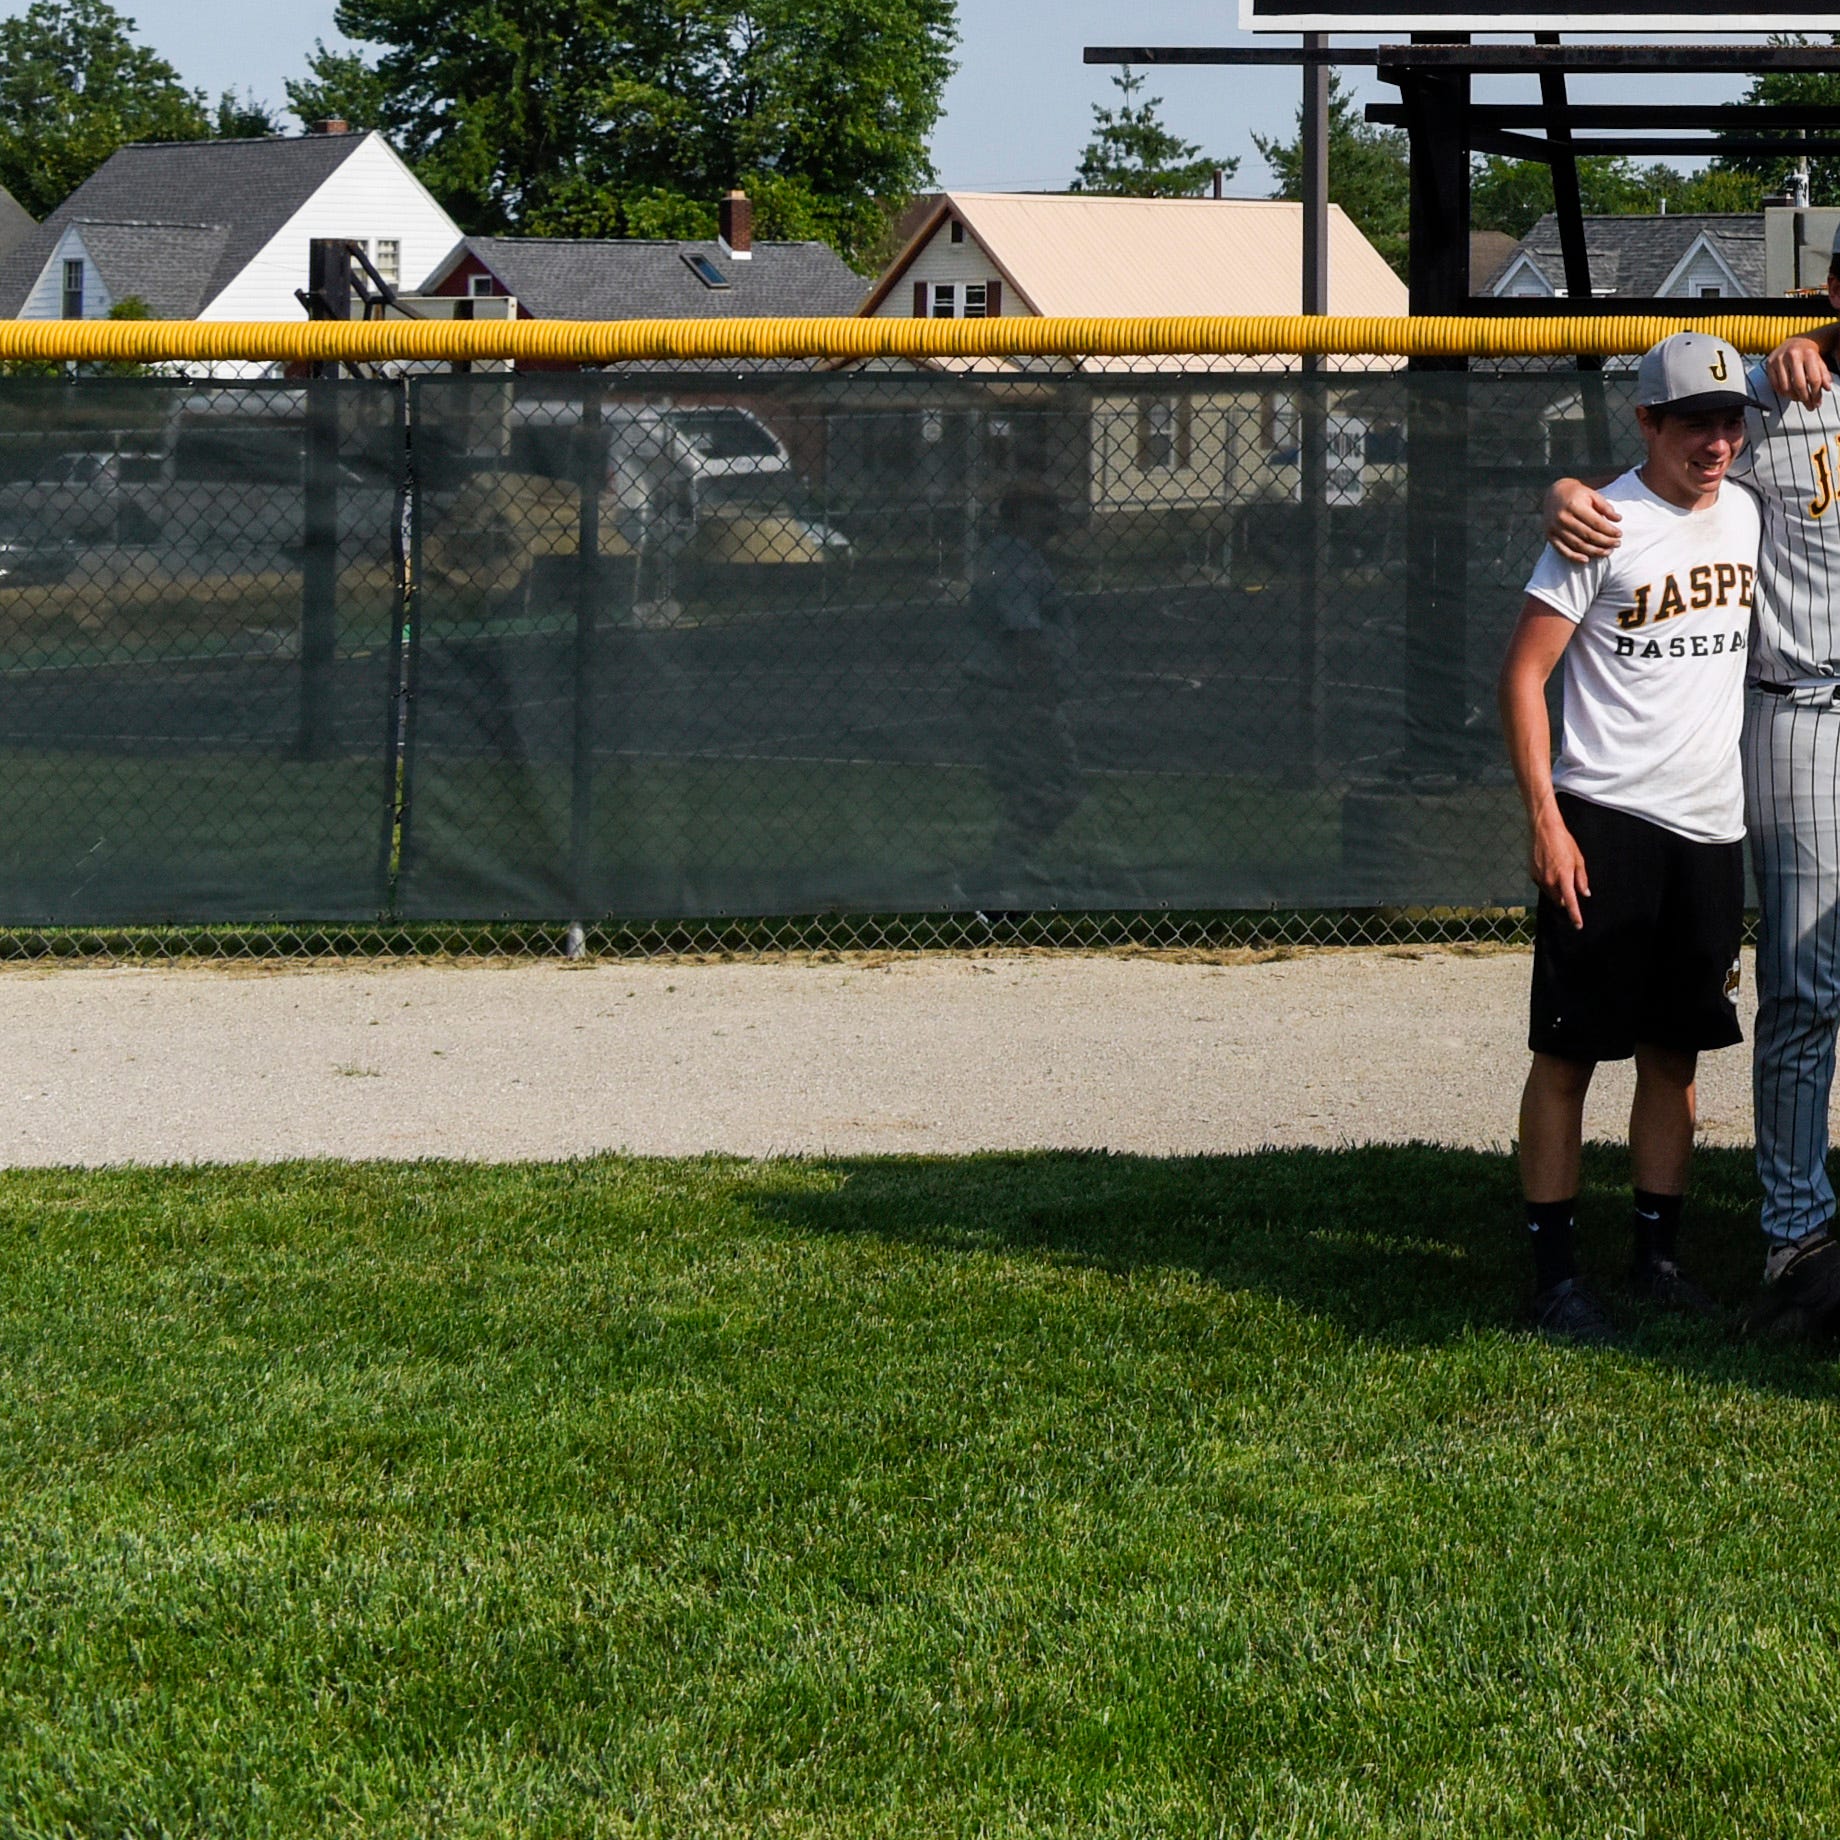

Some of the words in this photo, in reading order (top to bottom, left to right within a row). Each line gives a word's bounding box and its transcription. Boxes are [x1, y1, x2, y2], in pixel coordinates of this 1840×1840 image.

[1709, 350, 1728, 383] J
[1617, 563, 1756, 630] JASPE
[1616, 632, 1747, 657] BASEBA
